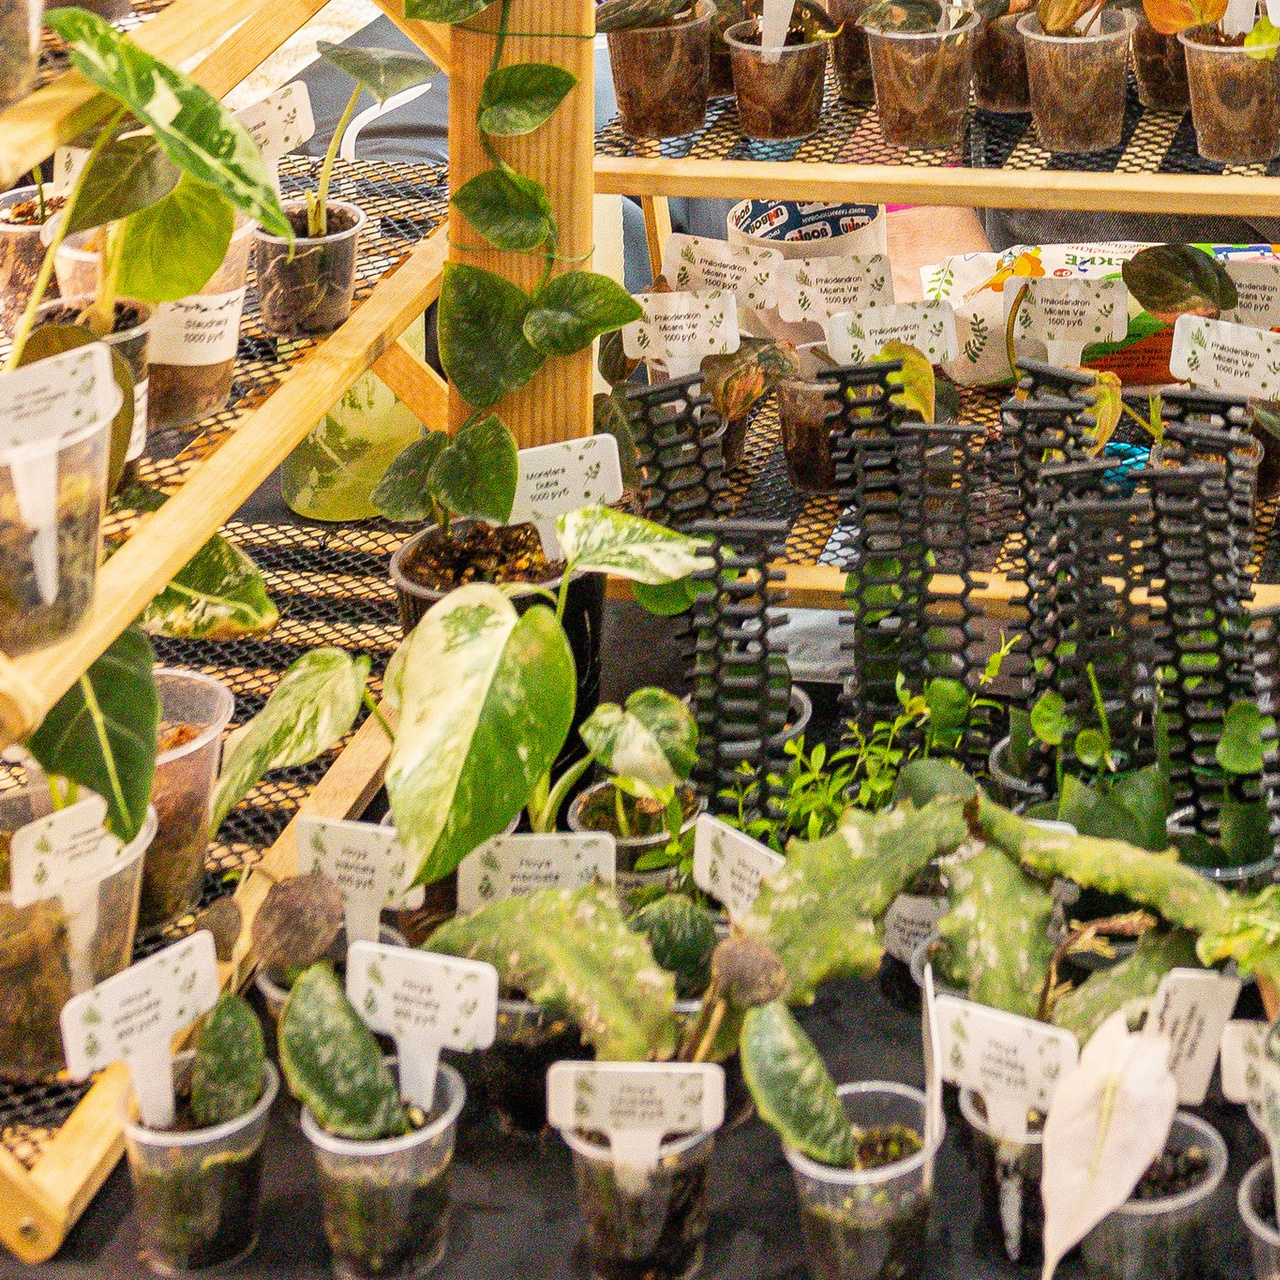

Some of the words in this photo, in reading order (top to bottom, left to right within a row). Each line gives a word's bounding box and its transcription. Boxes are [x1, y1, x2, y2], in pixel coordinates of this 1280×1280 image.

[700, 258, 747, 273] Philodendron
[702, 268, 726, 279] Micans
[816, 276, 862, 284] Philodendron
[1041, 297, 1090, 306] Philodendron
[870, 324, 919, 336] Philodendron
[1212, 342, 1260, 359] Philodendron
[1213, 353, 1238, 364] Micans
